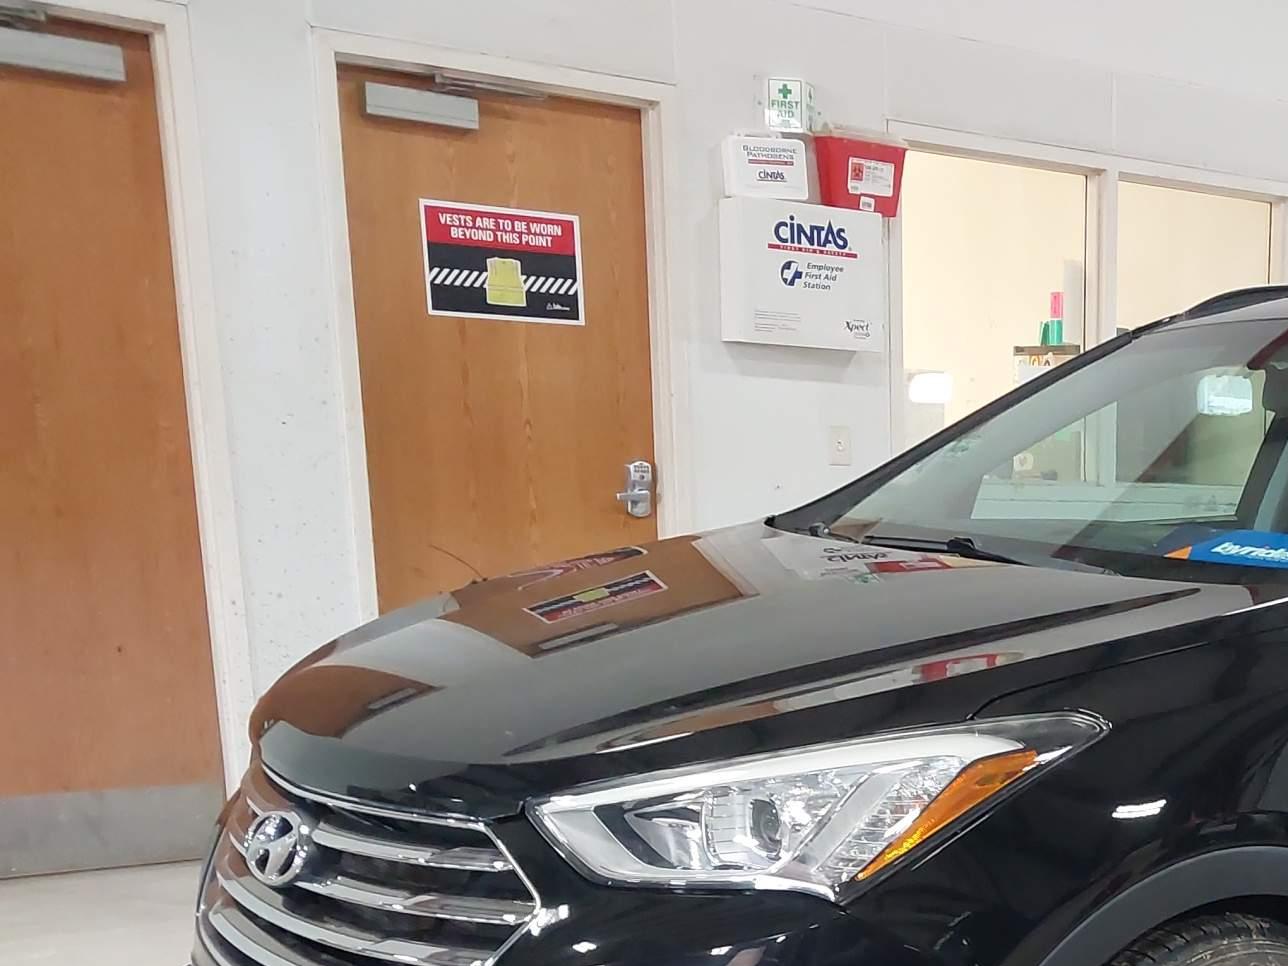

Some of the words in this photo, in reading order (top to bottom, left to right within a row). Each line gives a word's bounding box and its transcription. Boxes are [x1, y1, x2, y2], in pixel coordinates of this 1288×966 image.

[771, 99, 800, 110] FIRST
[777, 110, 794, 119] AID
[438, 212, 473, 227] VESTS
[475, 216, 497, 230] ARE
[497, 218, 512, 231] TO
[514, 220, 528, 233] BE
[529, 222, 562, 236] WORN
[450, 226, 494, 242] BEYOND
[496, 231, 520, 245] THIS
[521, 234, 553, 248] POINT
[806, 262, 844, 273] Employee
[804, 271, 822, 280] First
[823, 272, 837, 281] Aid
[803, 281, 831, 291] Station
